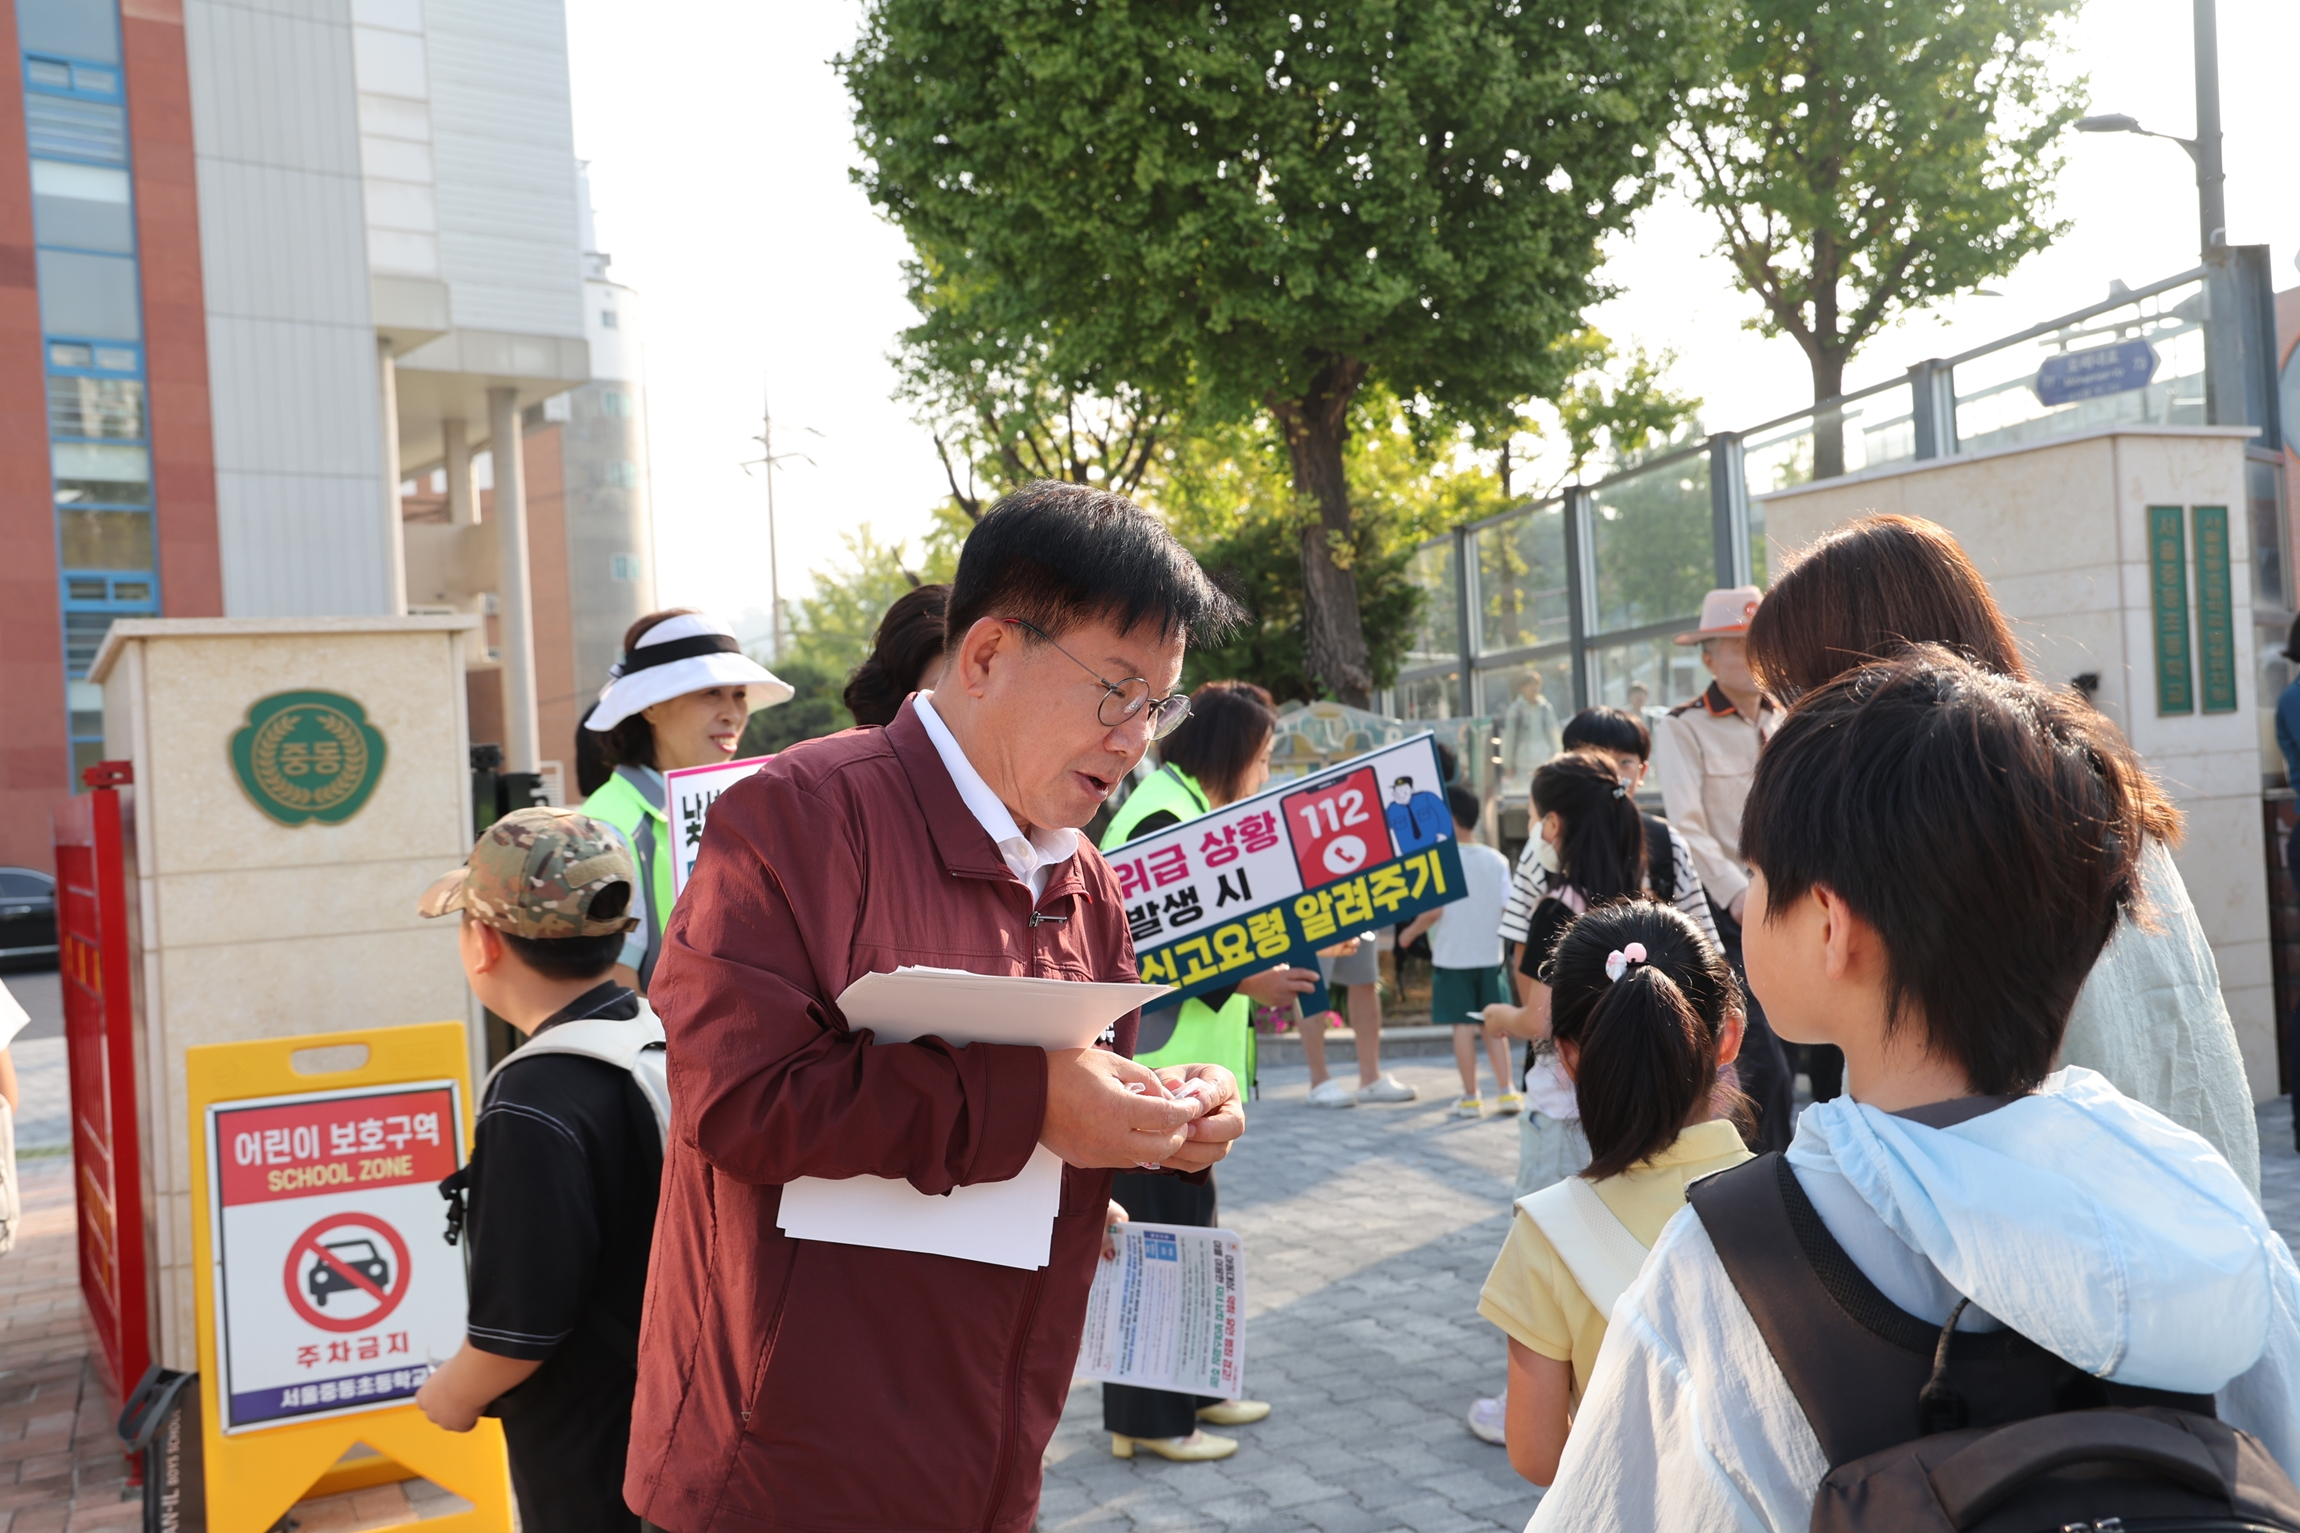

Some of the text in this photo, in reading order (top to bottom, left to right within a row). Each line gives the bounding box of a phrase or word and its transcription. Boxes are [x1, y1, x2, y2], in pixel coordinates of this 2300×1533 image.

[280, 742, 342, 776] 중동
[1299, 789, 1370, 839] 112
[1113, 810, 1280, 899] 위급 상황
[1125, 867, 1253, 943] 발생 시
[1140, 849, 1447, 991] 신고요령 알려주기
[234, 1111, 440, 1166] 어린이 보호구역
[267, 1154, 414, 1193] SCHOOL ZONE
[297, 1331, 410, 1369] 주차금지
[280, 1368, 429, 1409] 서울중동초등학교
[166, 1455, 180, 1487] BOYS
